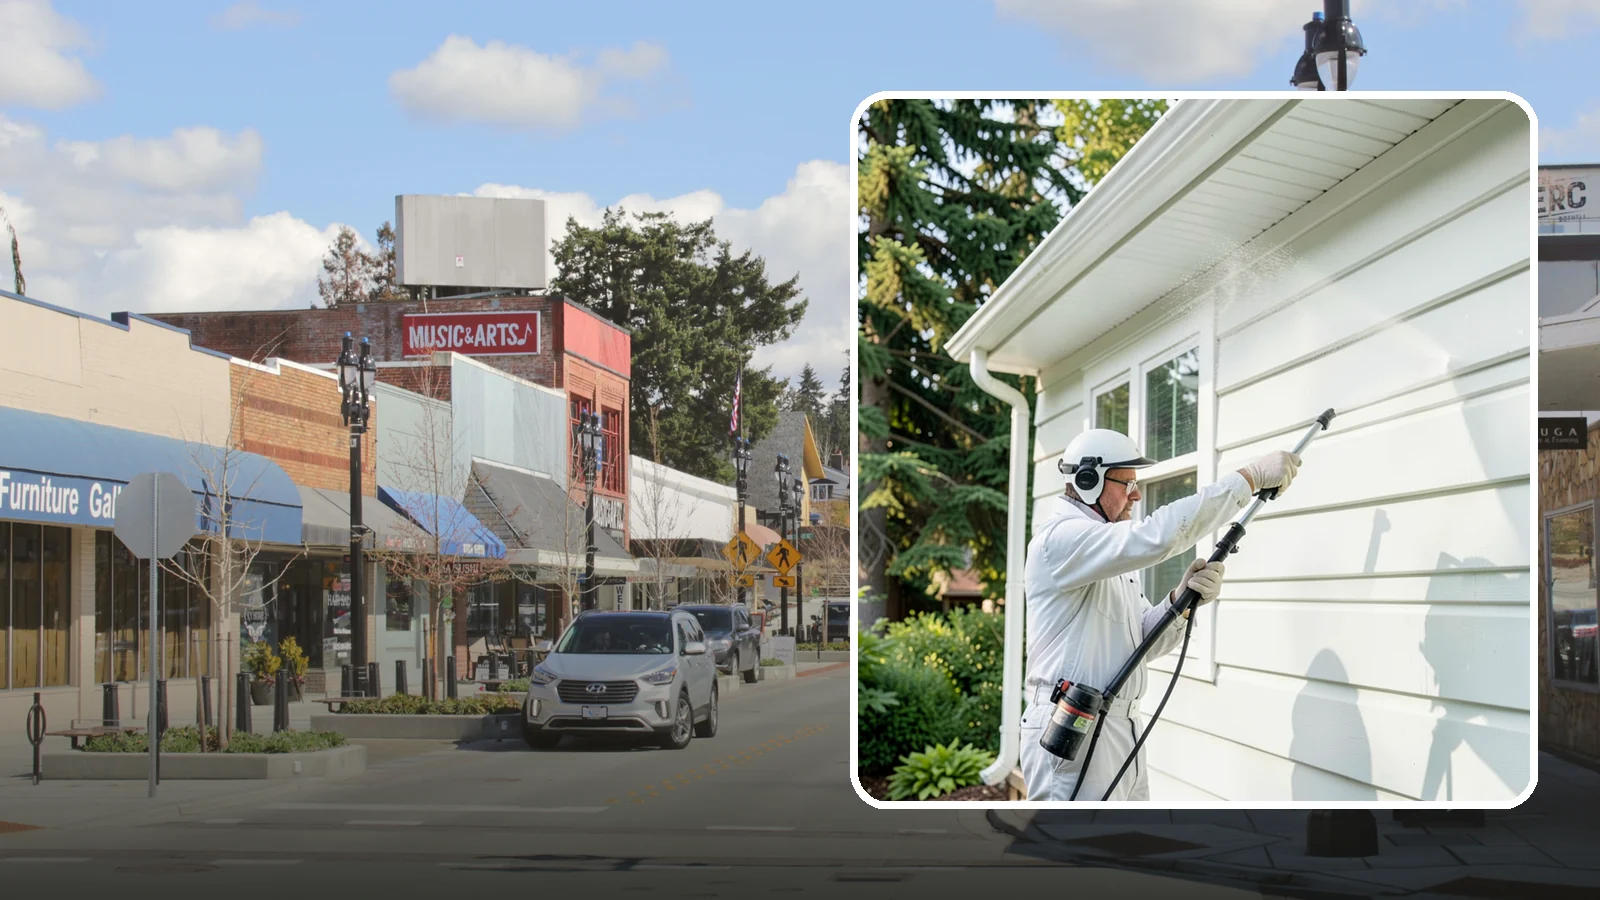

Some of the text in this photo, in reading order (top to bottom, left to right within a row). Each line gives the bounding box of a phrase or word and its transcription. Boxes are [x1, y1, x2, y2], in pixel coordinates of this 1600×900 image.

[409, 323, 519, 348] MUSIC&ARTS
[0, 472, 122, 519] Furniture Gal
